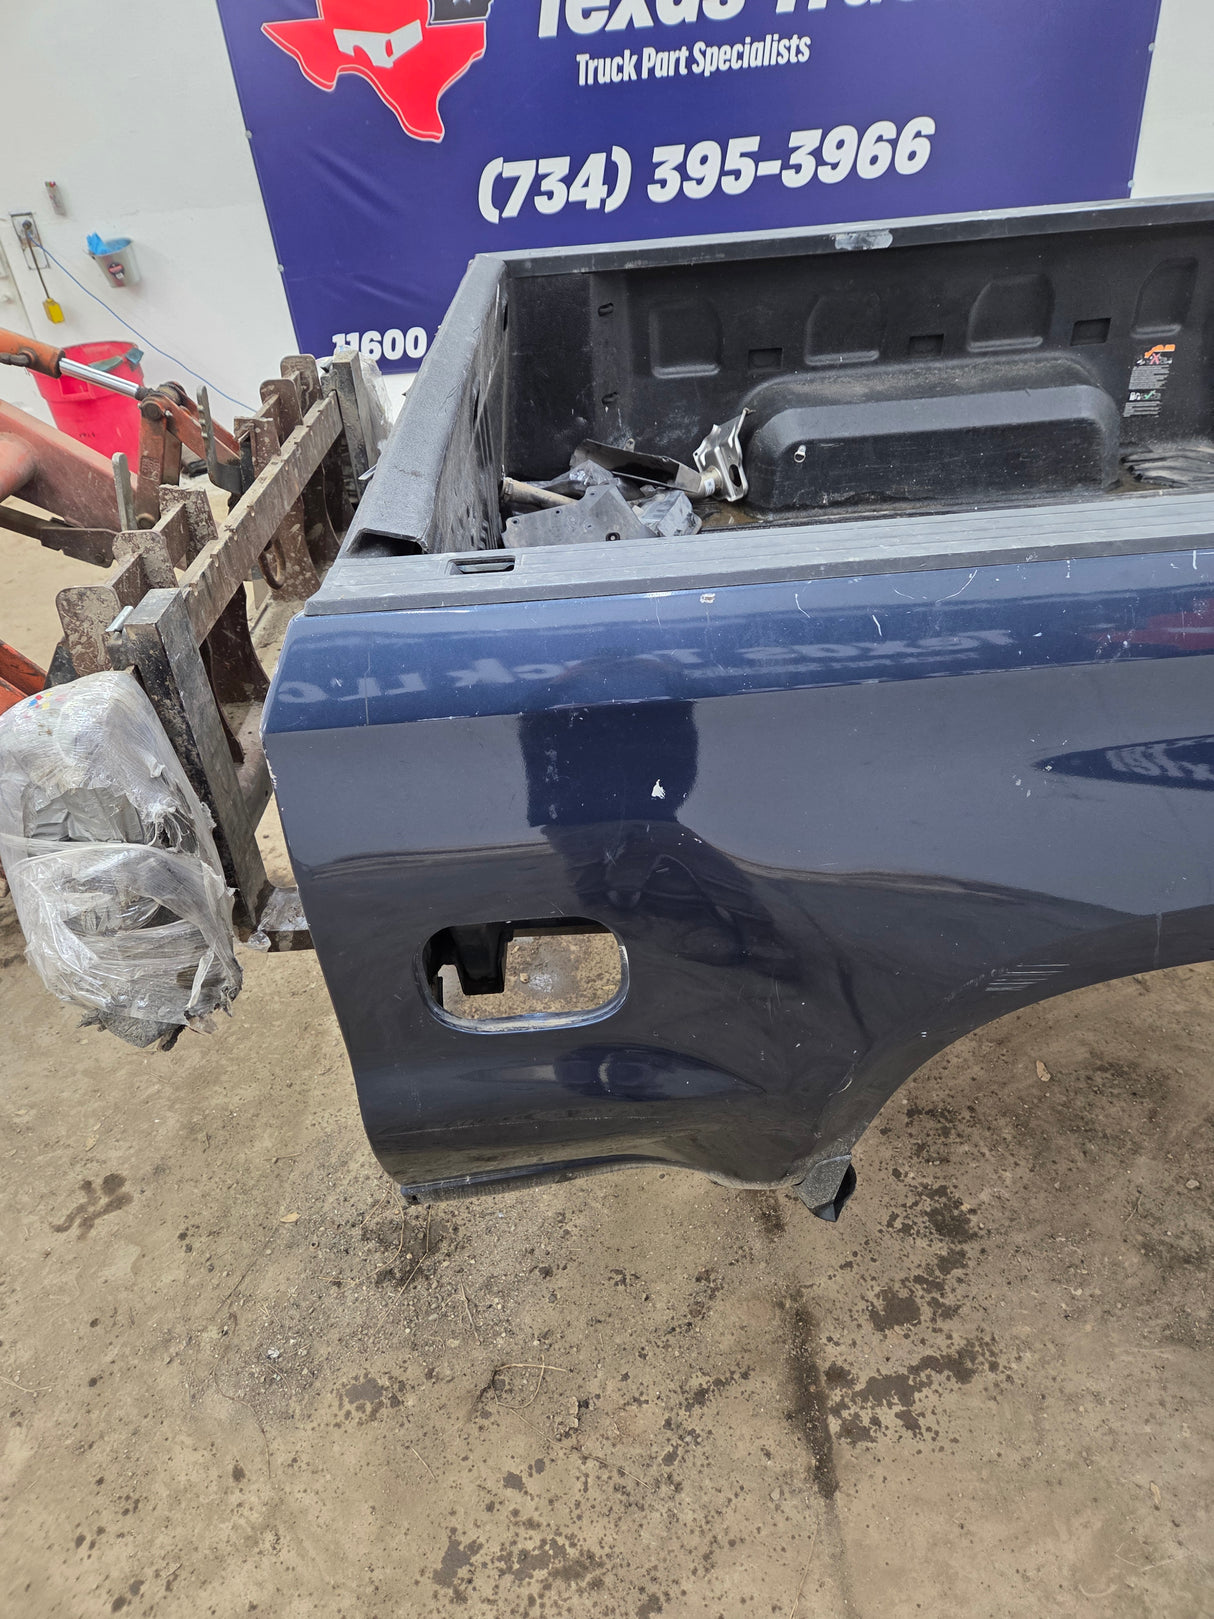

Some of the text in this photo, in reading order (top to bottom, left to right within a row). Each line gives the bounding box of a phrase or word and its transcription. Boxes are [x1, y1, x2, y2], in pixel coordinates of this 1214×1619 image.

[576, 33, 812, 86] Truck Part Specialists
[478, 116, 937, 224] (734) 395-3966
